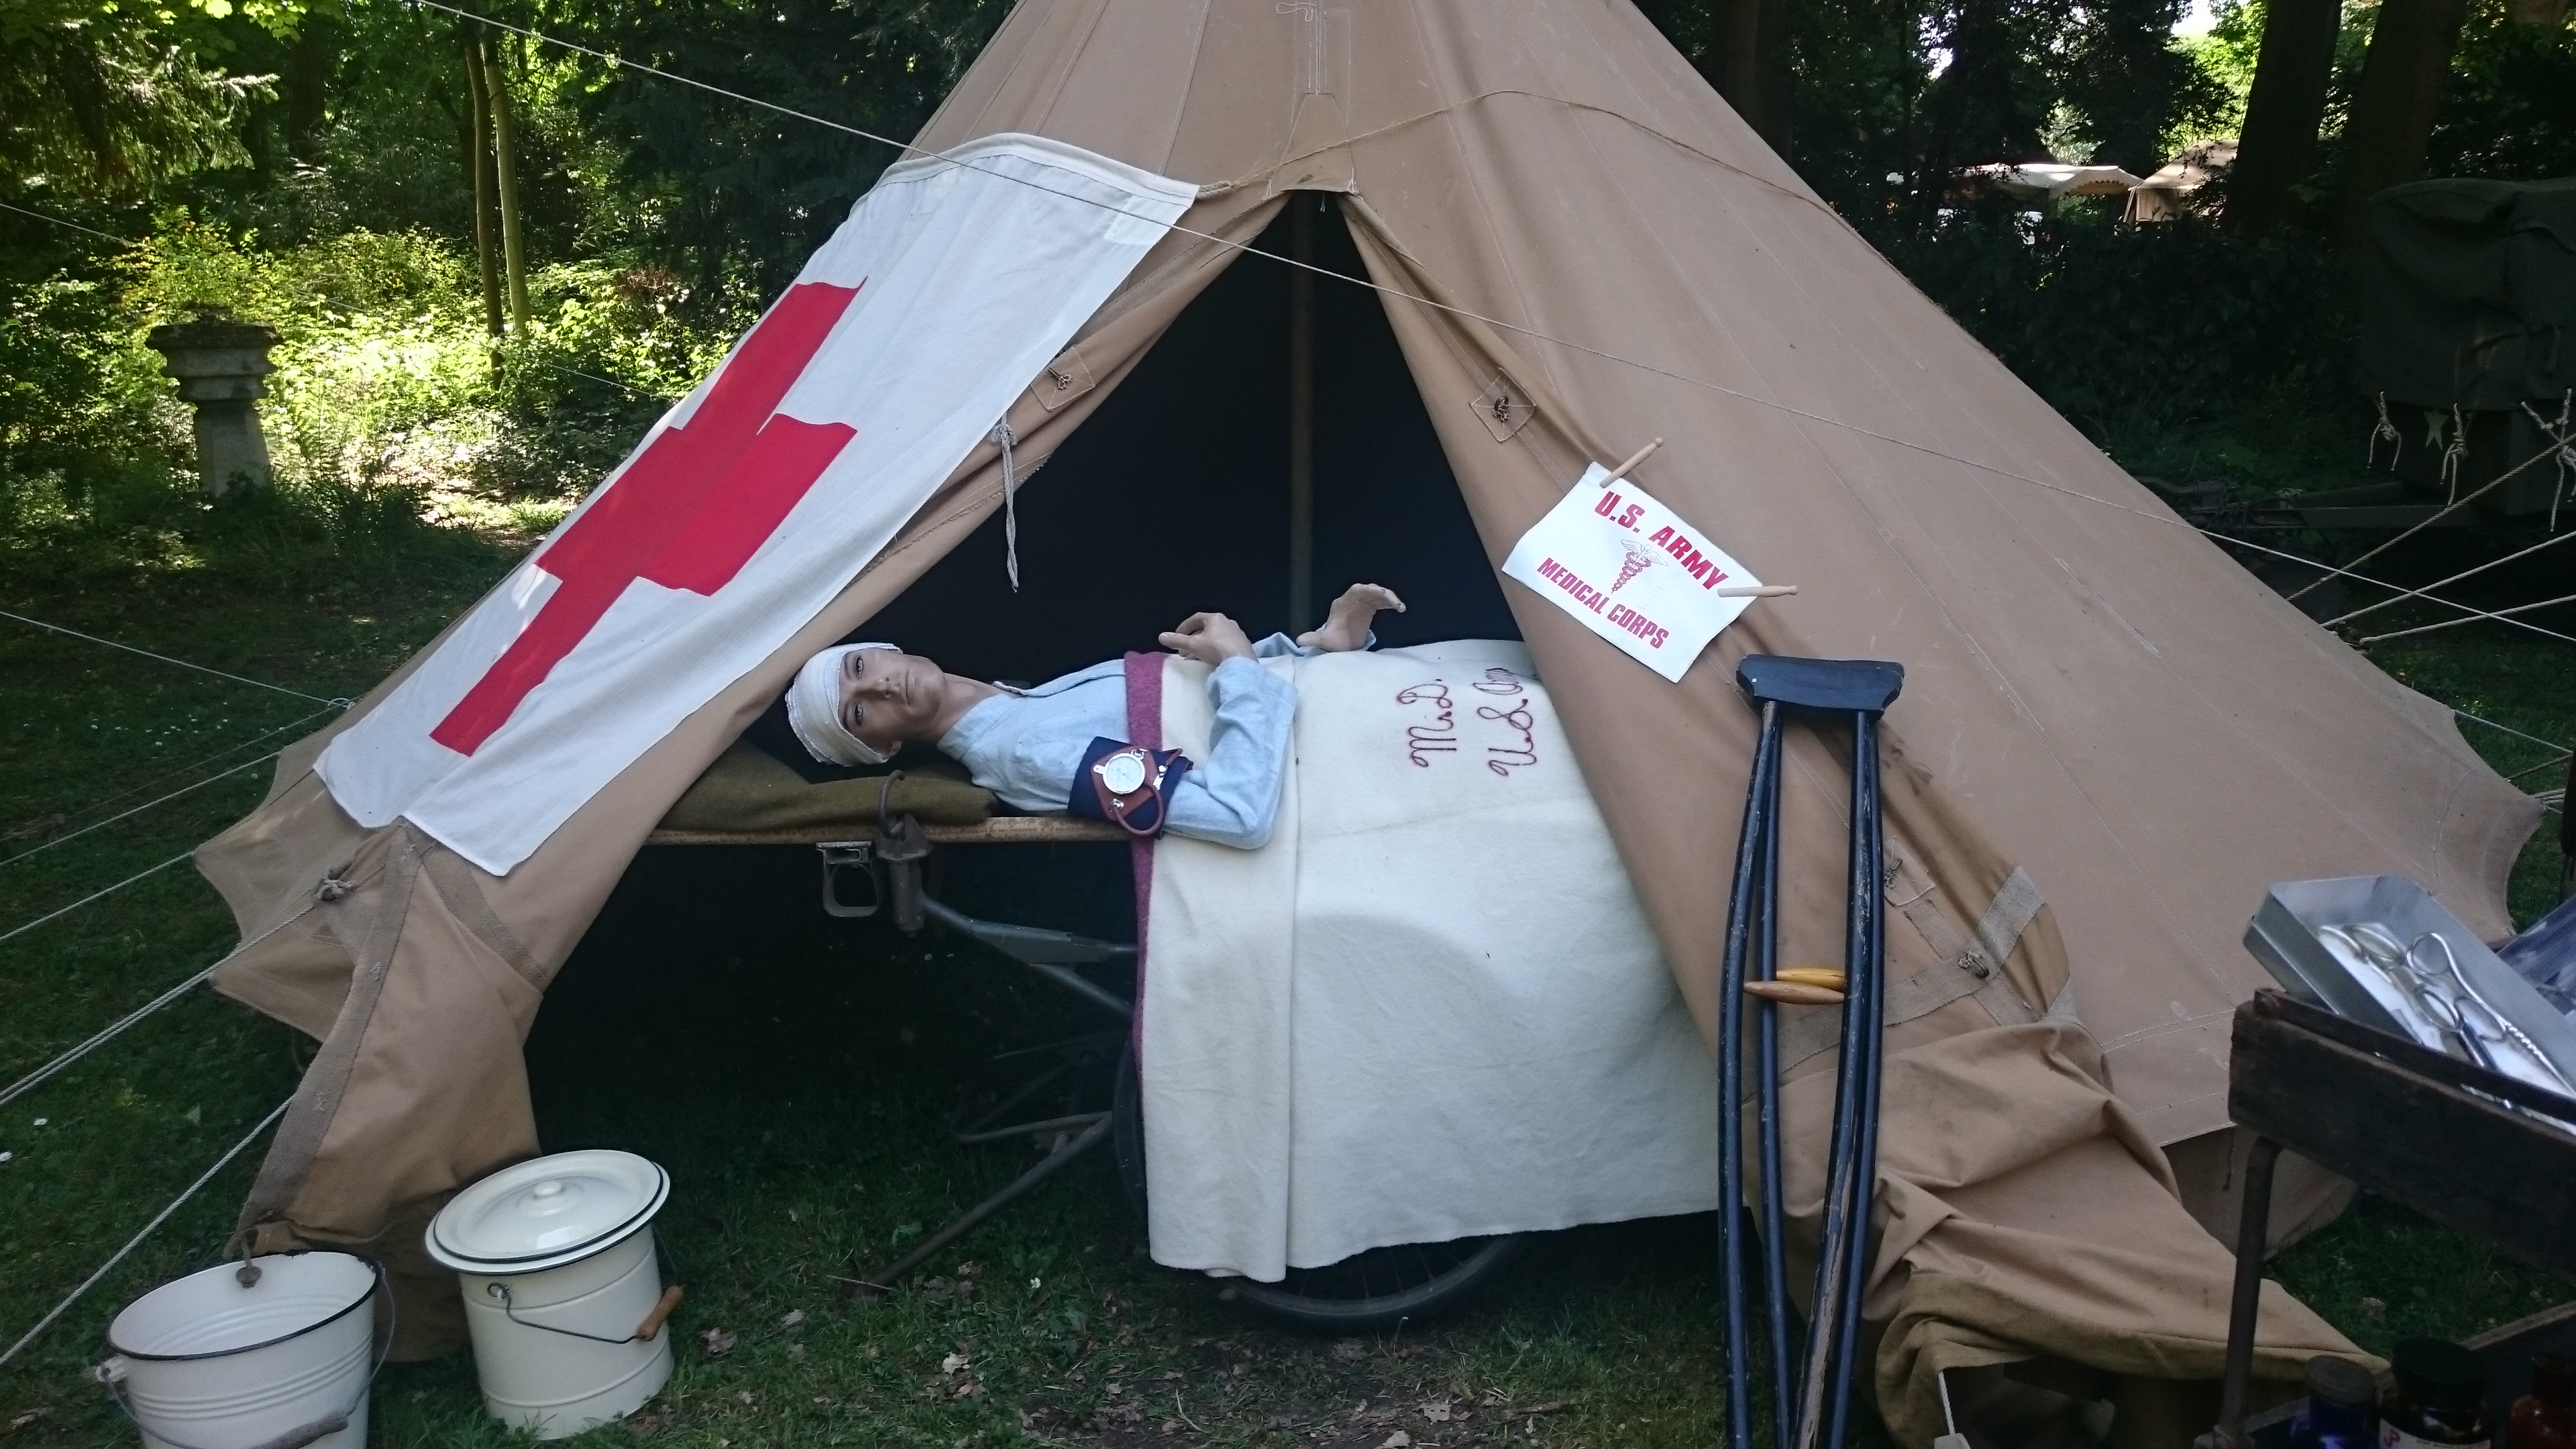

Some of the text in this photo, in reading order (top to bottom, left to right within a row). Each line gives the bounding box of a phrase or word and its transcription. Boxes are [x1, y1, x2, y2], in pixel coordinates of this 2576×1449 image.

[1595, 491, 1729, 590] U.S. ARMY
[1536, 557, 1670, 649] MEDICAL CORPS
